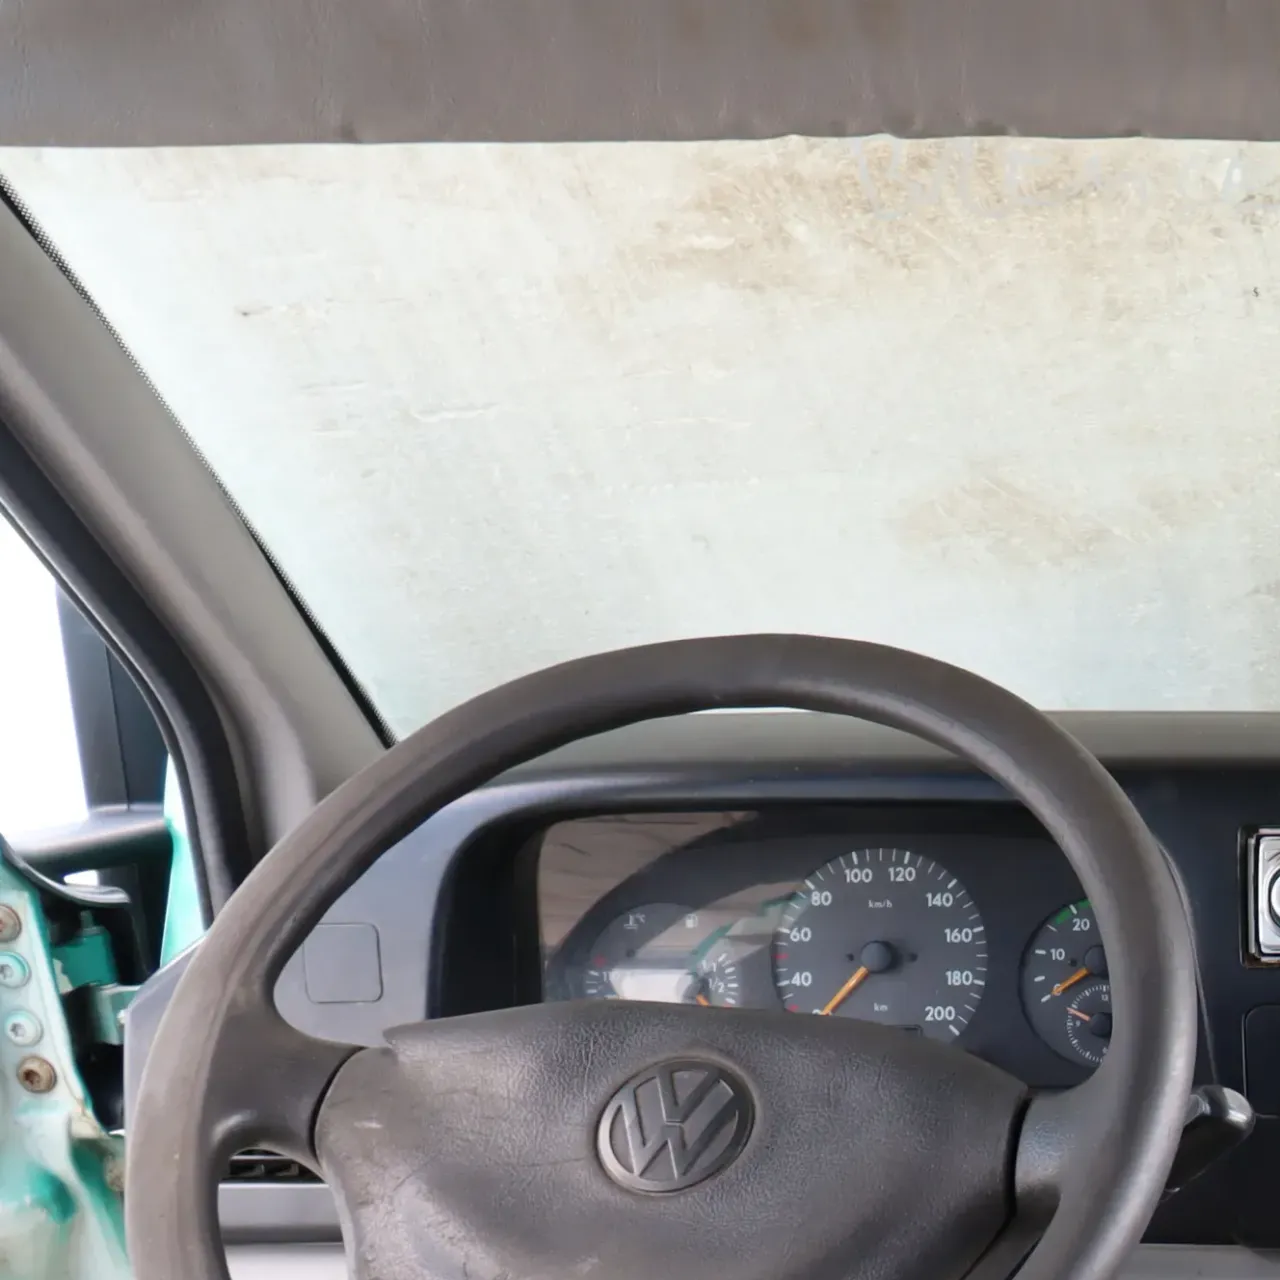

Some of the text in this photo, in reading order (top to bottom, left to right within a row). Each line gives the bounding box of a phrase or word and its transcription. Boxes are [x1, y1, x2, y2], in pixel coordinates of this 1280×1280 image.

[844, 868, 872, 883] 100
[888, 867, 915, 882] 120
[811, 891, 832, 906] 80
[868, 899, 892, 909] km/h
[926, 893, 953, 907] 140
[1072, 918, 1090, 931] 20
[790, 927, 812, 942] 60
[945, 928, 972, 943] 160
[1050, 948, 1065, 961] 10
[791, 972, 812, 986] 40
[946, 971, 972, 985] 180
[874, 1002, 888, 1011] km
[925, 1006, 955, 1021] 200
